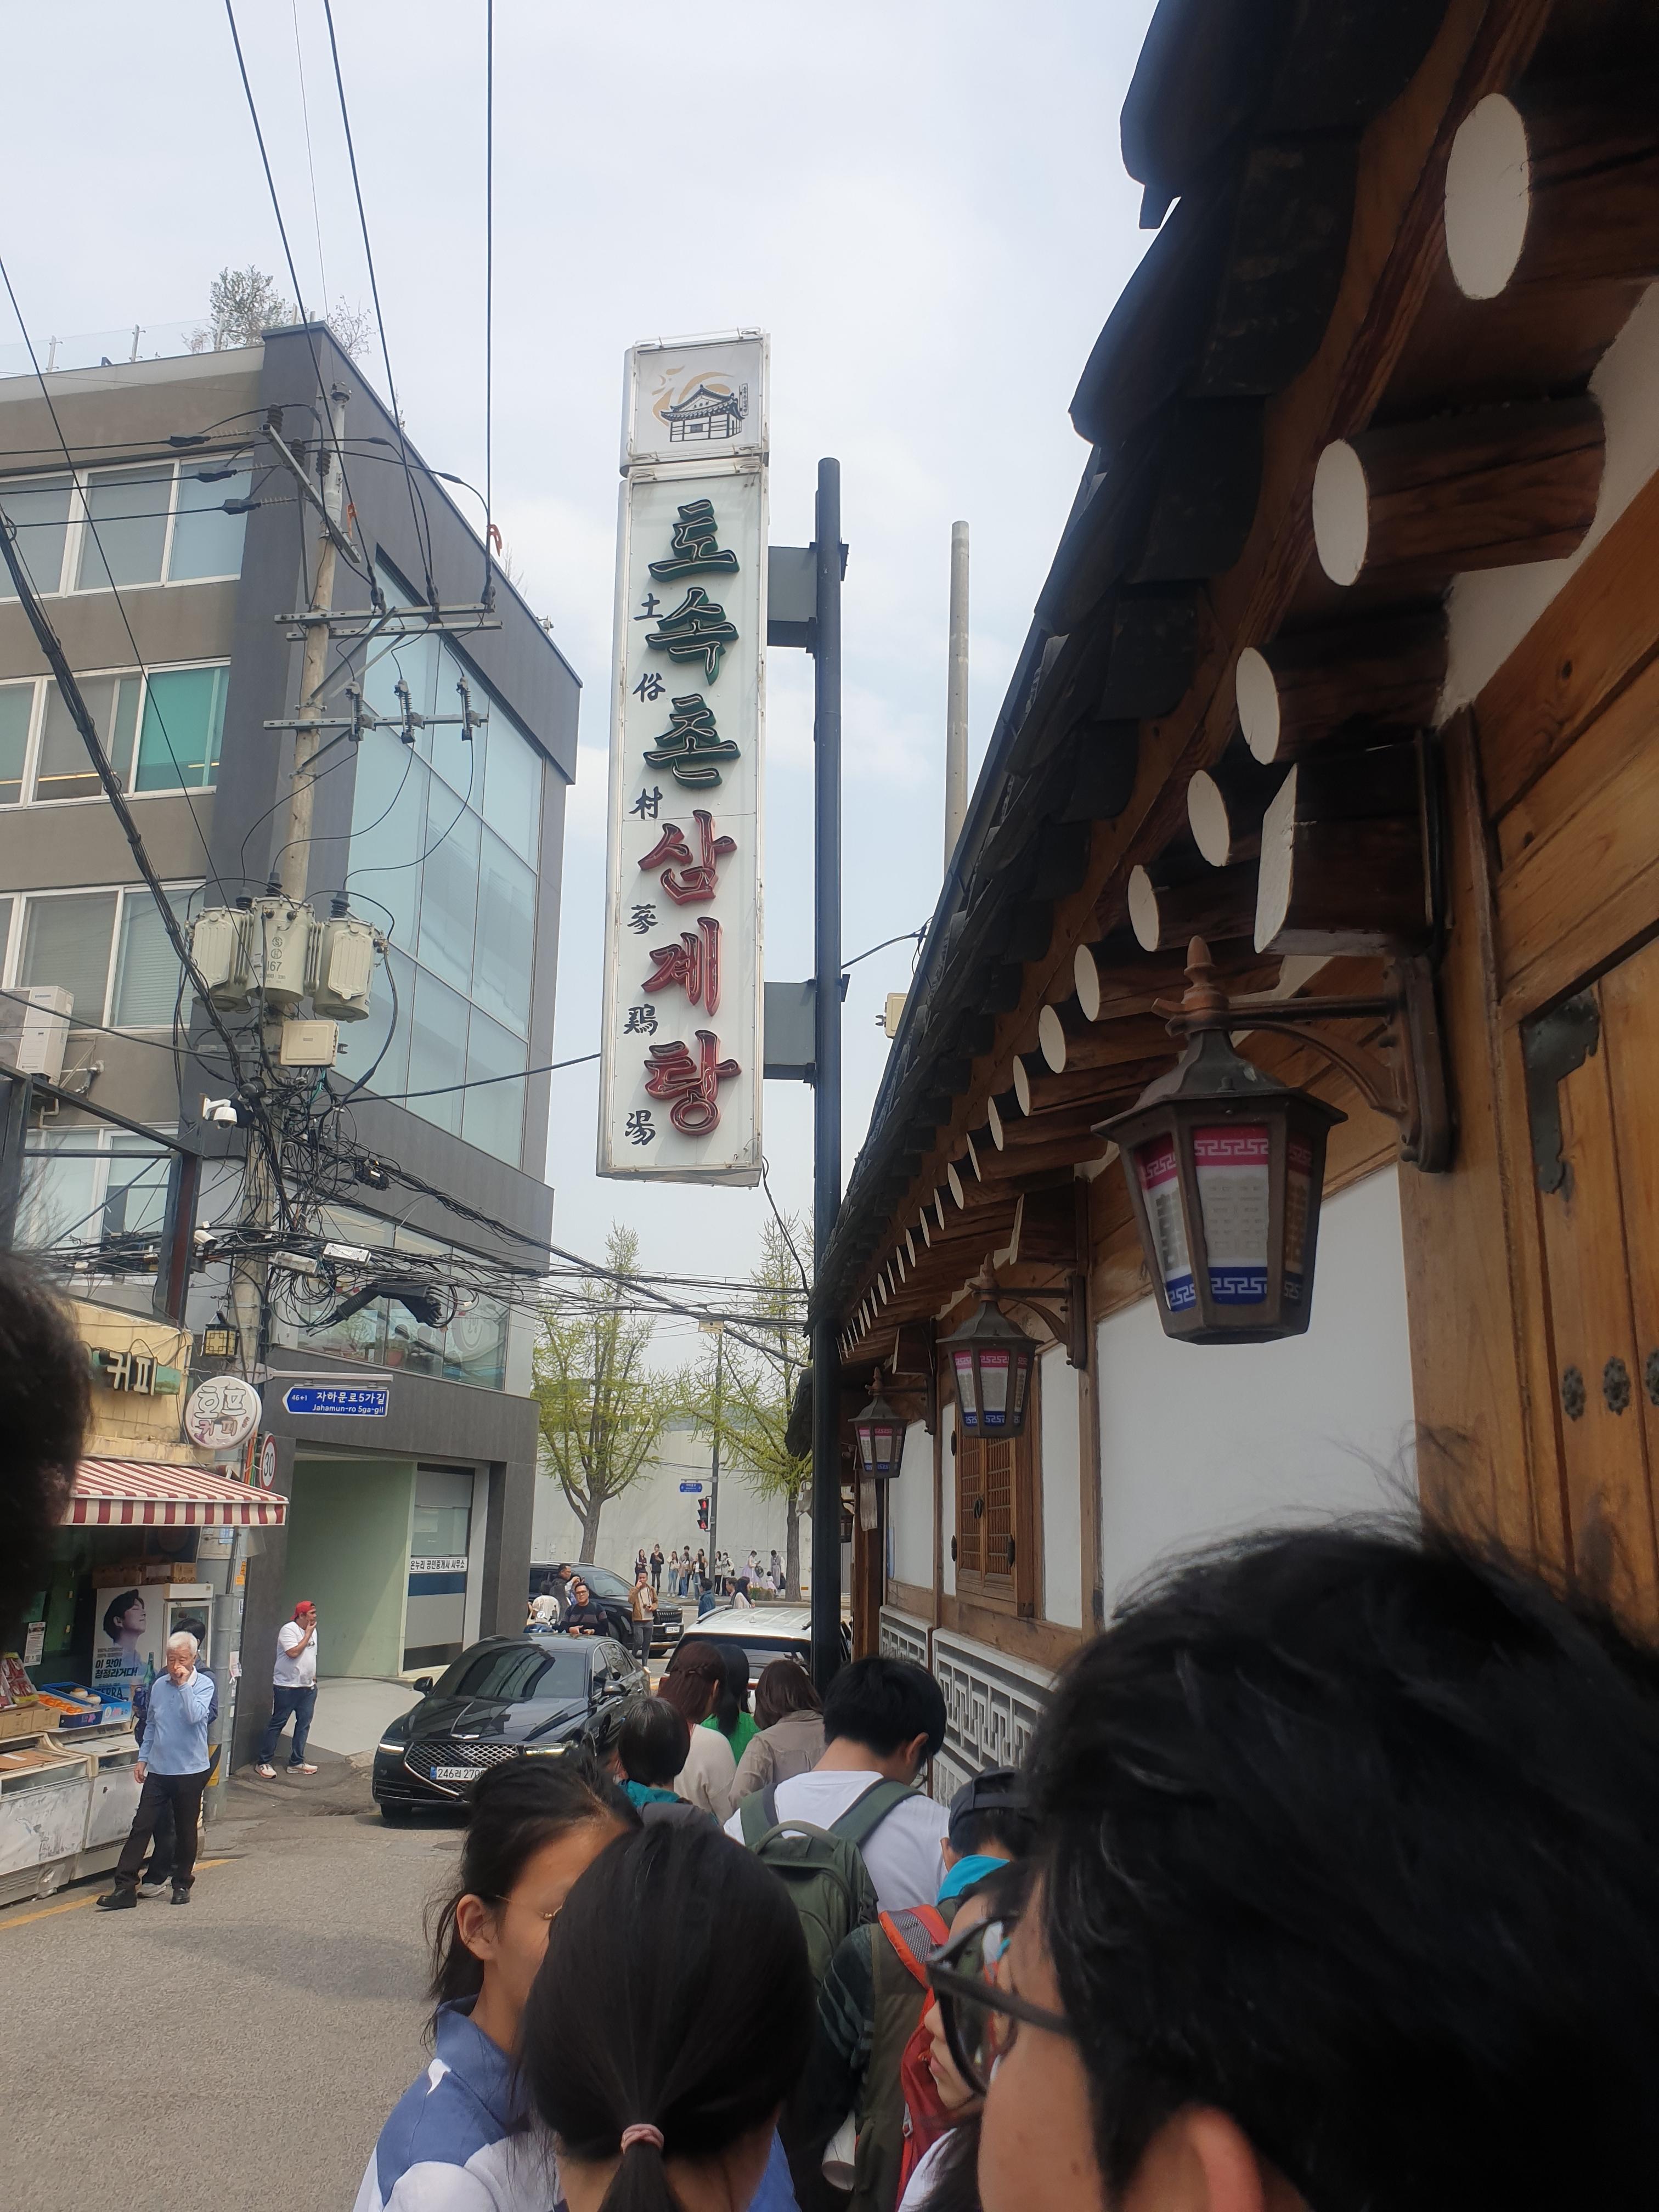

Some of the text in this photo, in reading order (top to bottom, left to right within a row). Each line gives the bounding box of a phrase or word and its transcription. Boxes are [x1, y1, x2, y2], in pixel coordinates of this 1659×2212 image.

[107, 1351, 157, 1396] 커피
[194, 1386, 247, 1419] 호프
[317, 1391, 385, 1404] 자하문로5가길
[358, 1406, 383, 1414] 5ga-gil
[195, 1419, 238, 1437] 커피
[264, 1452, 274, 1477] 30
[410, 1560, 465, 1570] 온누리 공인중개사 사무소
[95, 1658, 122, 1669] 이 맛이
